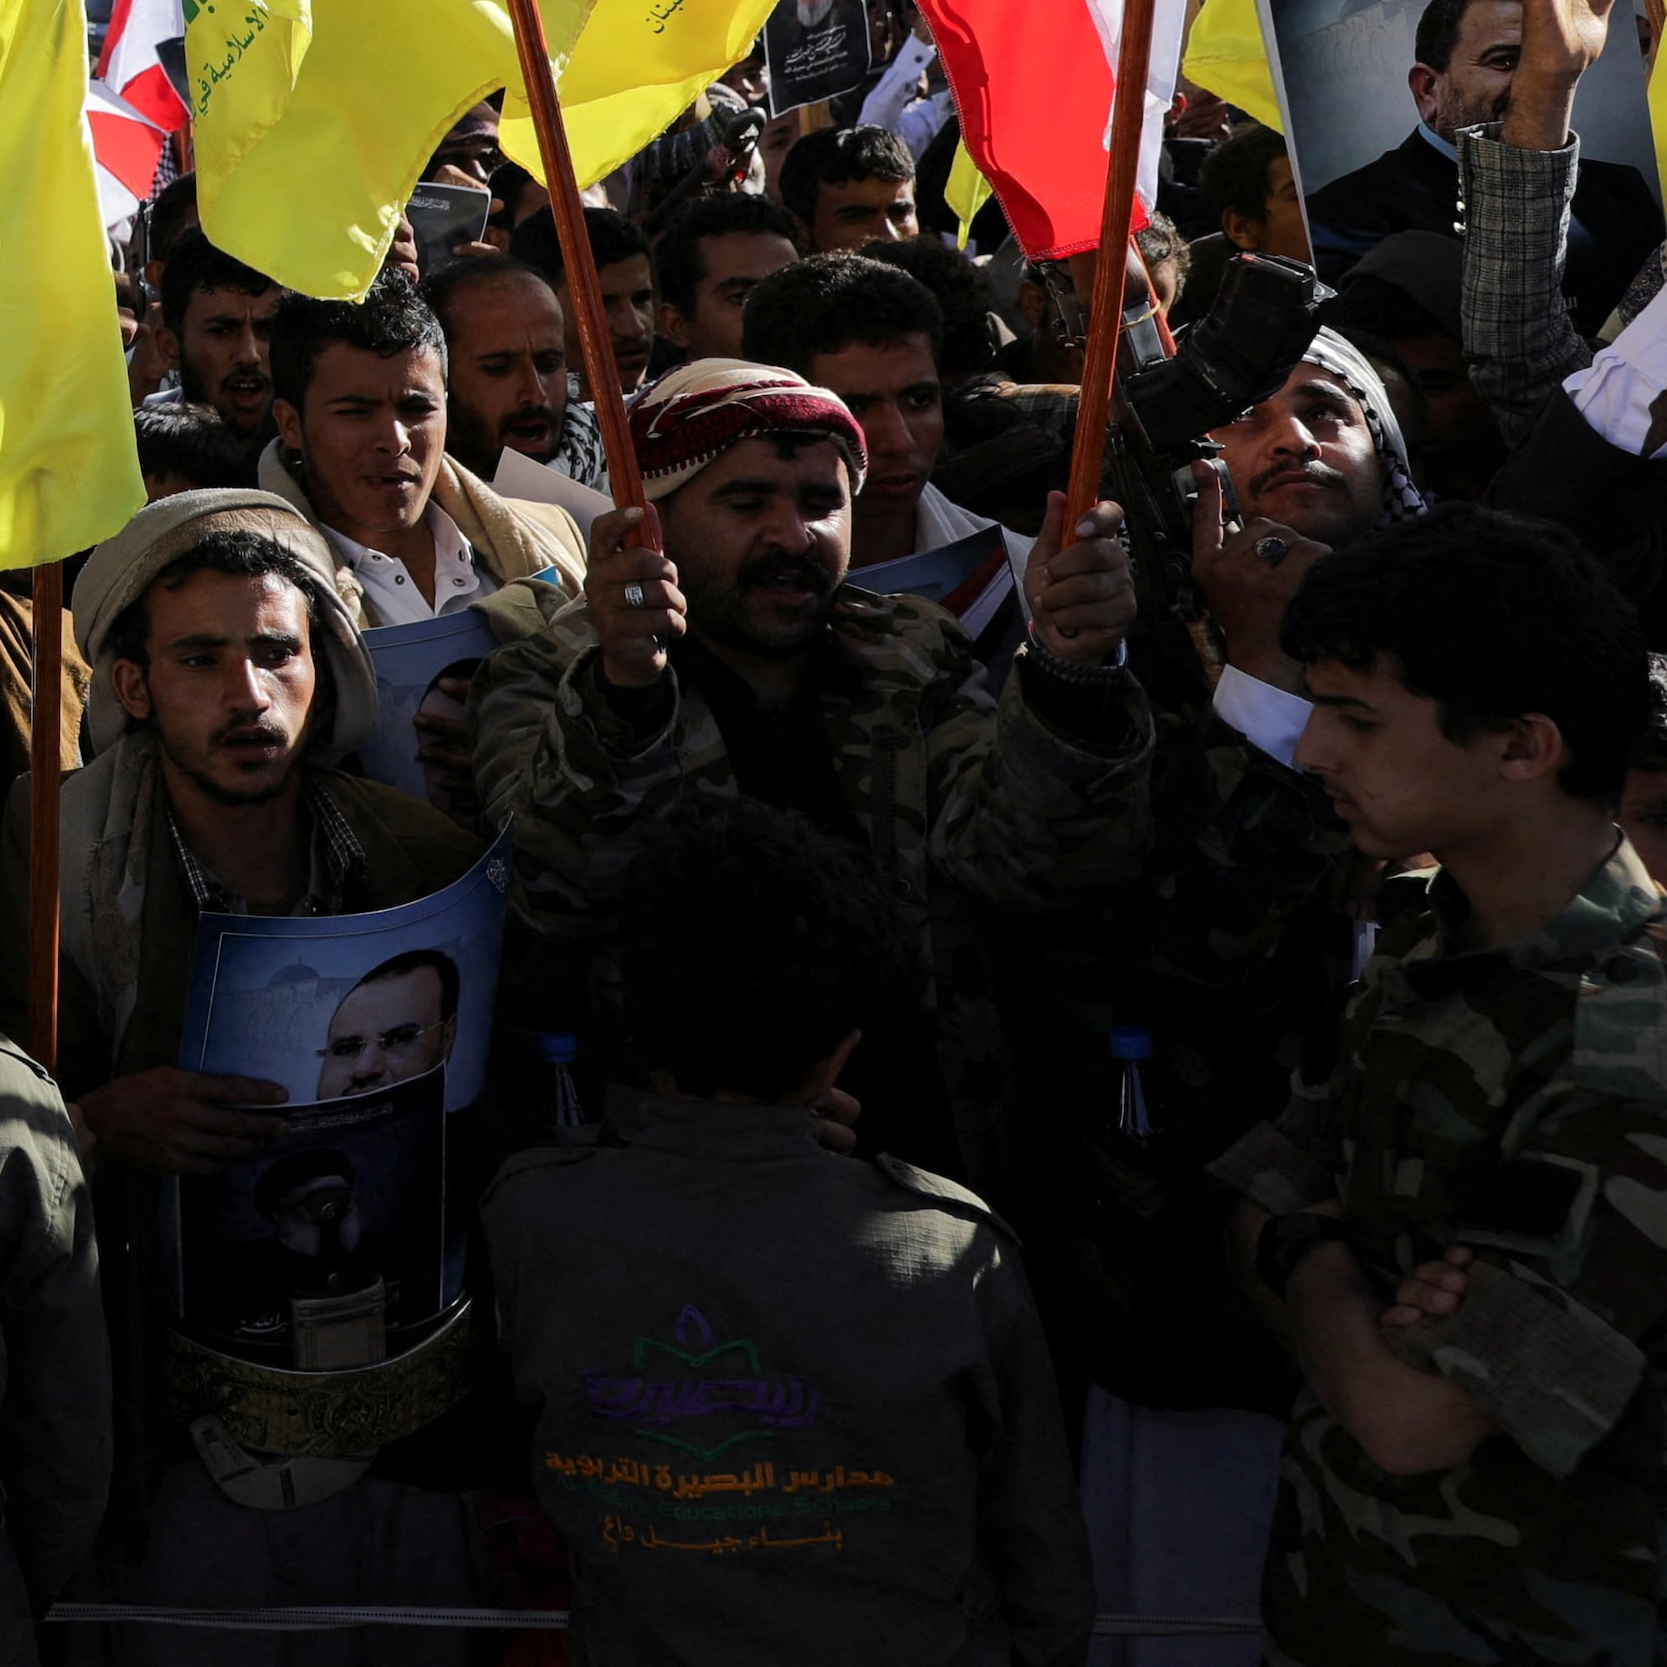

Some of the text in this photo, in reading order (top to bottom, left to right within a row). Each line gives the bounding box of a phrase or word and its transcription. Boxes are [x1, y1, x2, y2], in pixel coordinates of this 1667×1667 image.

[543, 1449, 895, 1500] مدارس البصيرة التربوية
[640, 1525, 743, 1556] جيل
[748, 1518, 845, 1551] بناء
